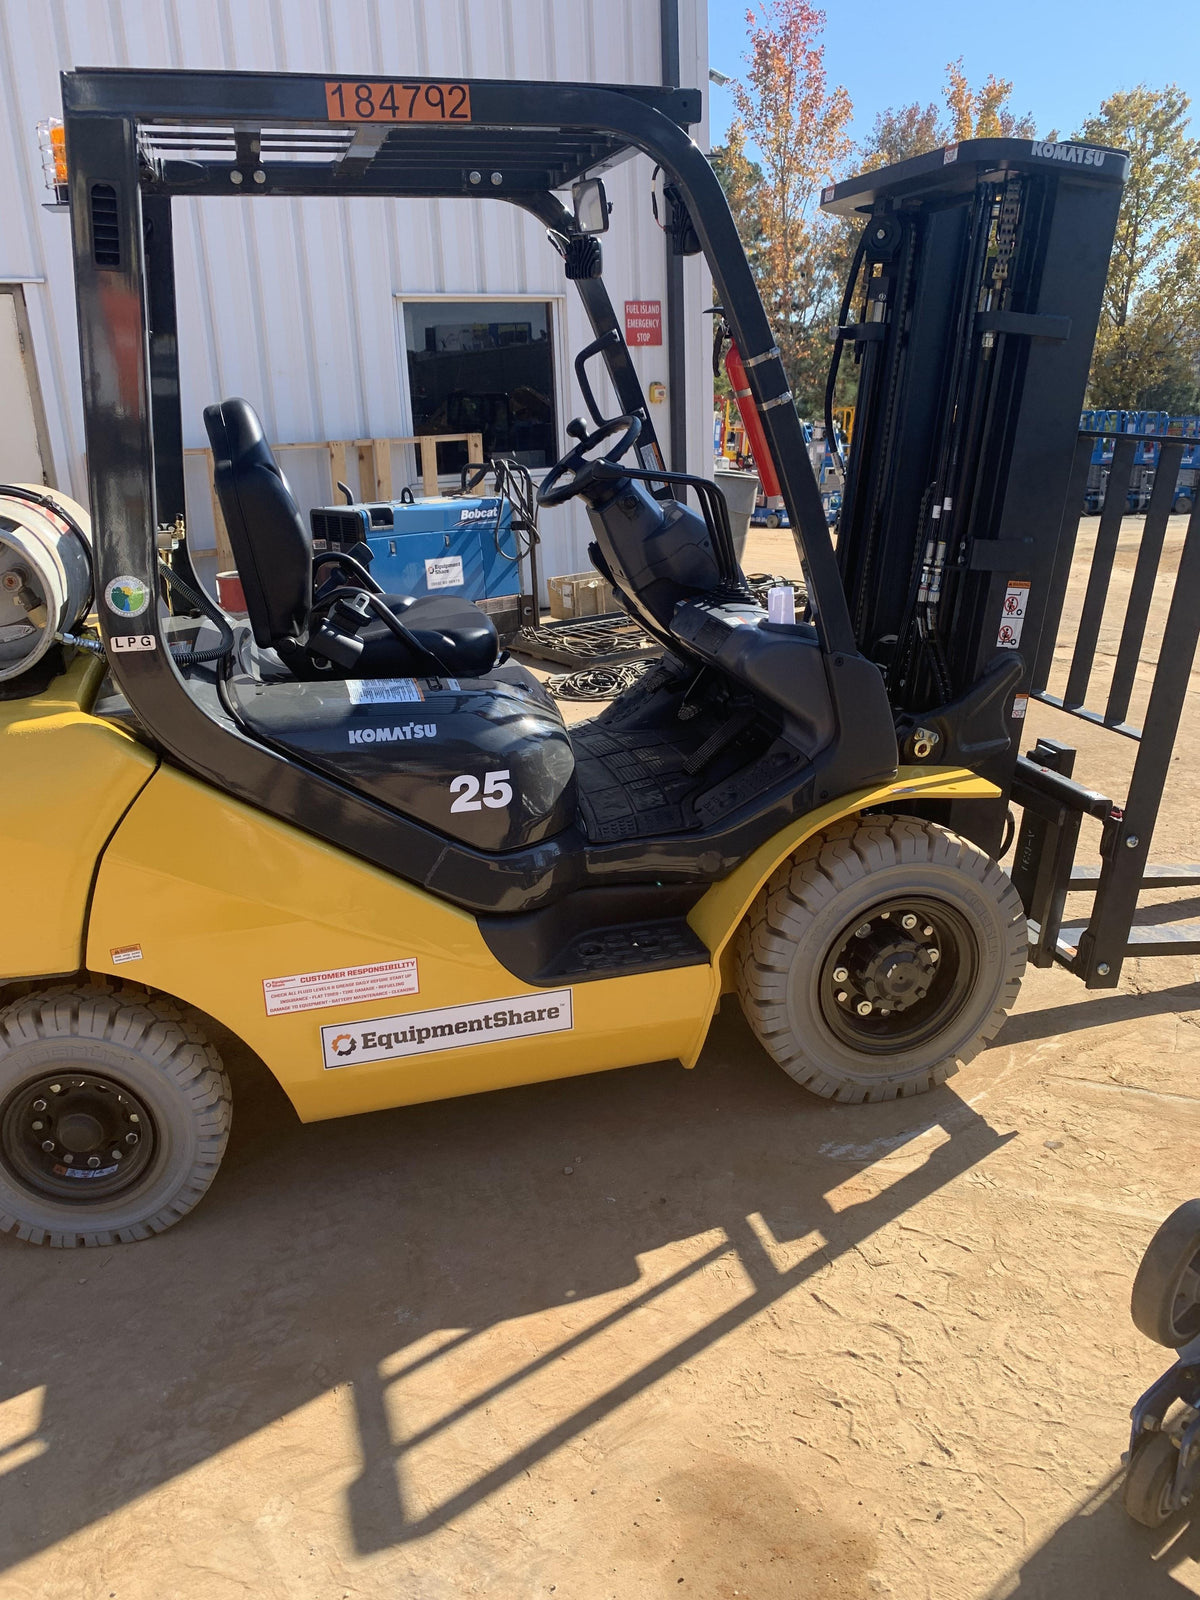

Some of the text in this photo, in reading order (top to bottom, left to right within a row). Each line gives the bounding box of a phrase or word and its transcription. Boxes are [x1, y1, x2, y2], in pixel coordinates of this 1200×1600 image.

[331, 83, 468, 119] 184792
[1031, 141, 1106, 167] KOMATSU
[626, 304, 660, 314] FUEL ISLAND
[627, 318, 660, 328] EMERGENCY
[636, 332, 650, 342] STOP
[460, 507, 498, 520] Bobcat
[348, 722, 438, 744] KOMATSU
[450, 770, 512, 814] 25
[300, 961, 416, 984] CUSTOMER RESPONSIBILITY
[361, 1004, 560, 1050] EquipmentShare
